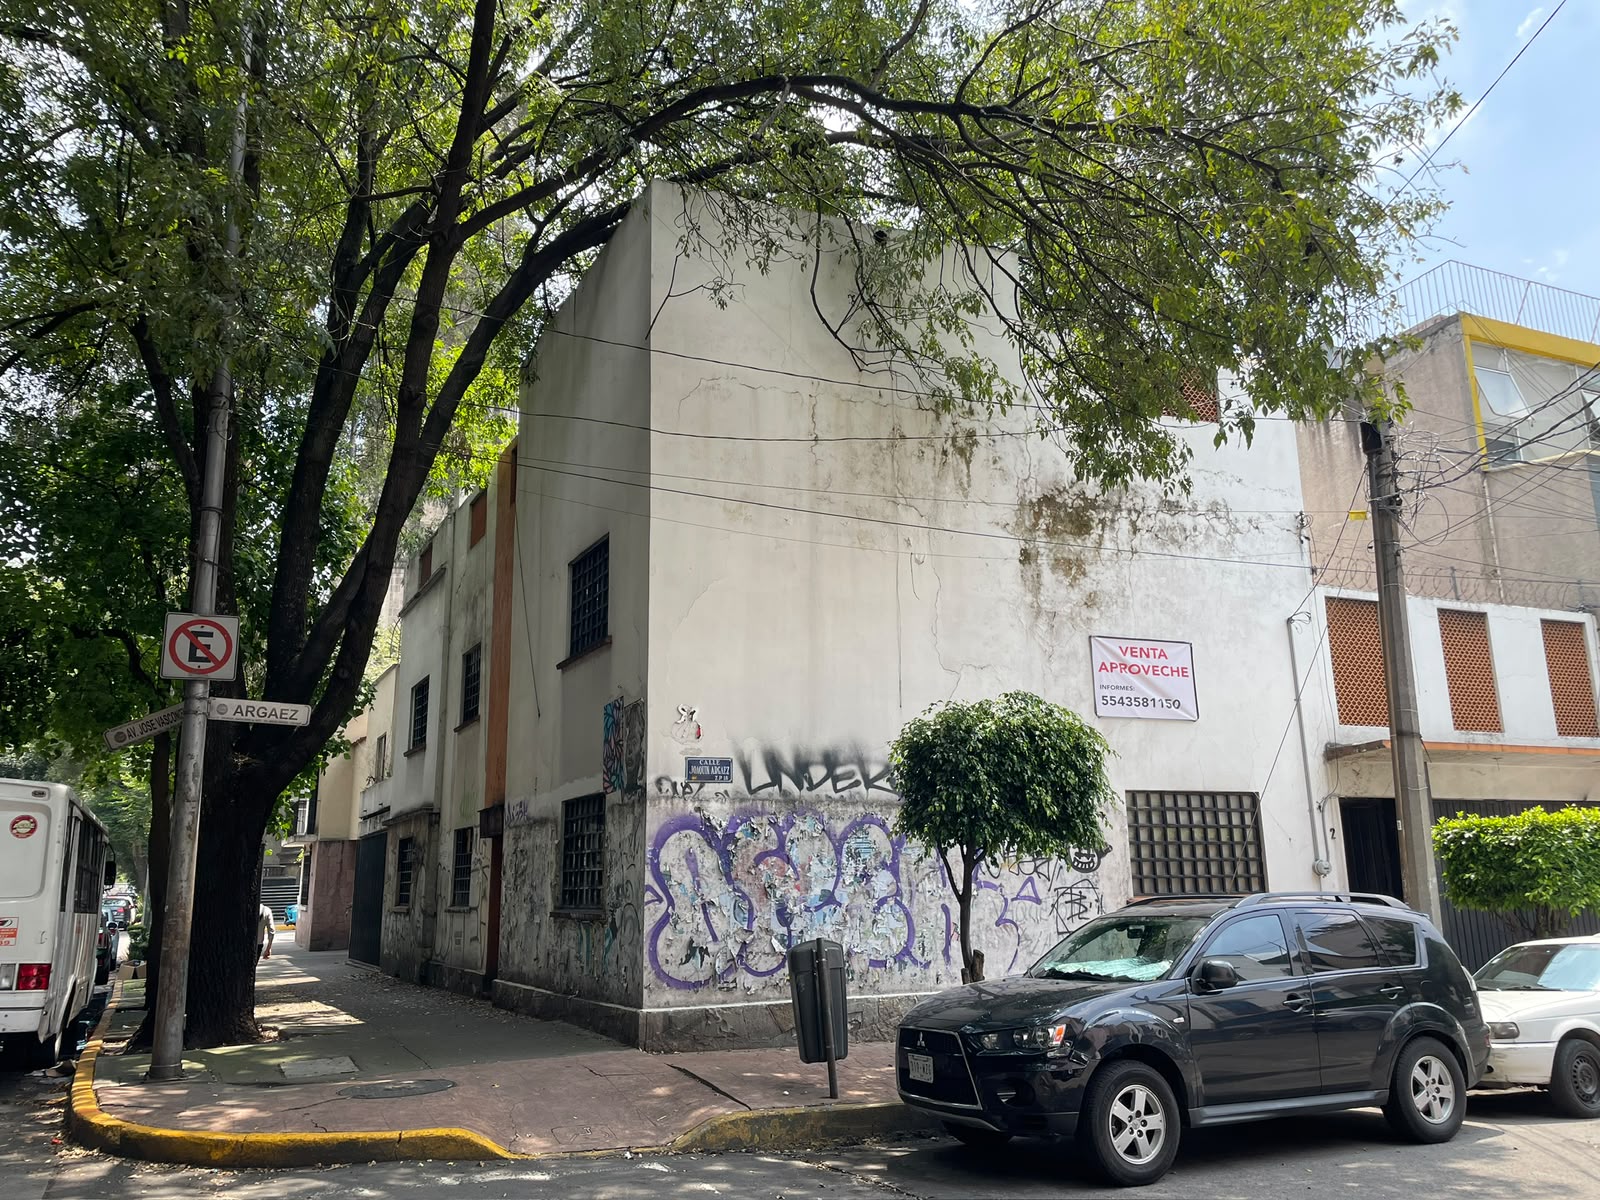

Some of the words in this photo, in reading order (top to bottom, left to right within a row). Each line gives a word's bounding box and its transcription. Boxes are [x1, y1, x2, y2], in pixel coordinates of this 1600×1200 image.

[188, 630, 214, 663] E
[1118, 646, 1168, 660] VENTA
[1098, 662, 1189, 678] APROVECHE
[1101, 695, 1181, 710] 5543581150
[233, 704, 299, 721] ARGAEZ
[140, 719, 157, 735] JOSE
[1329, 827, 1336, 840] 2
